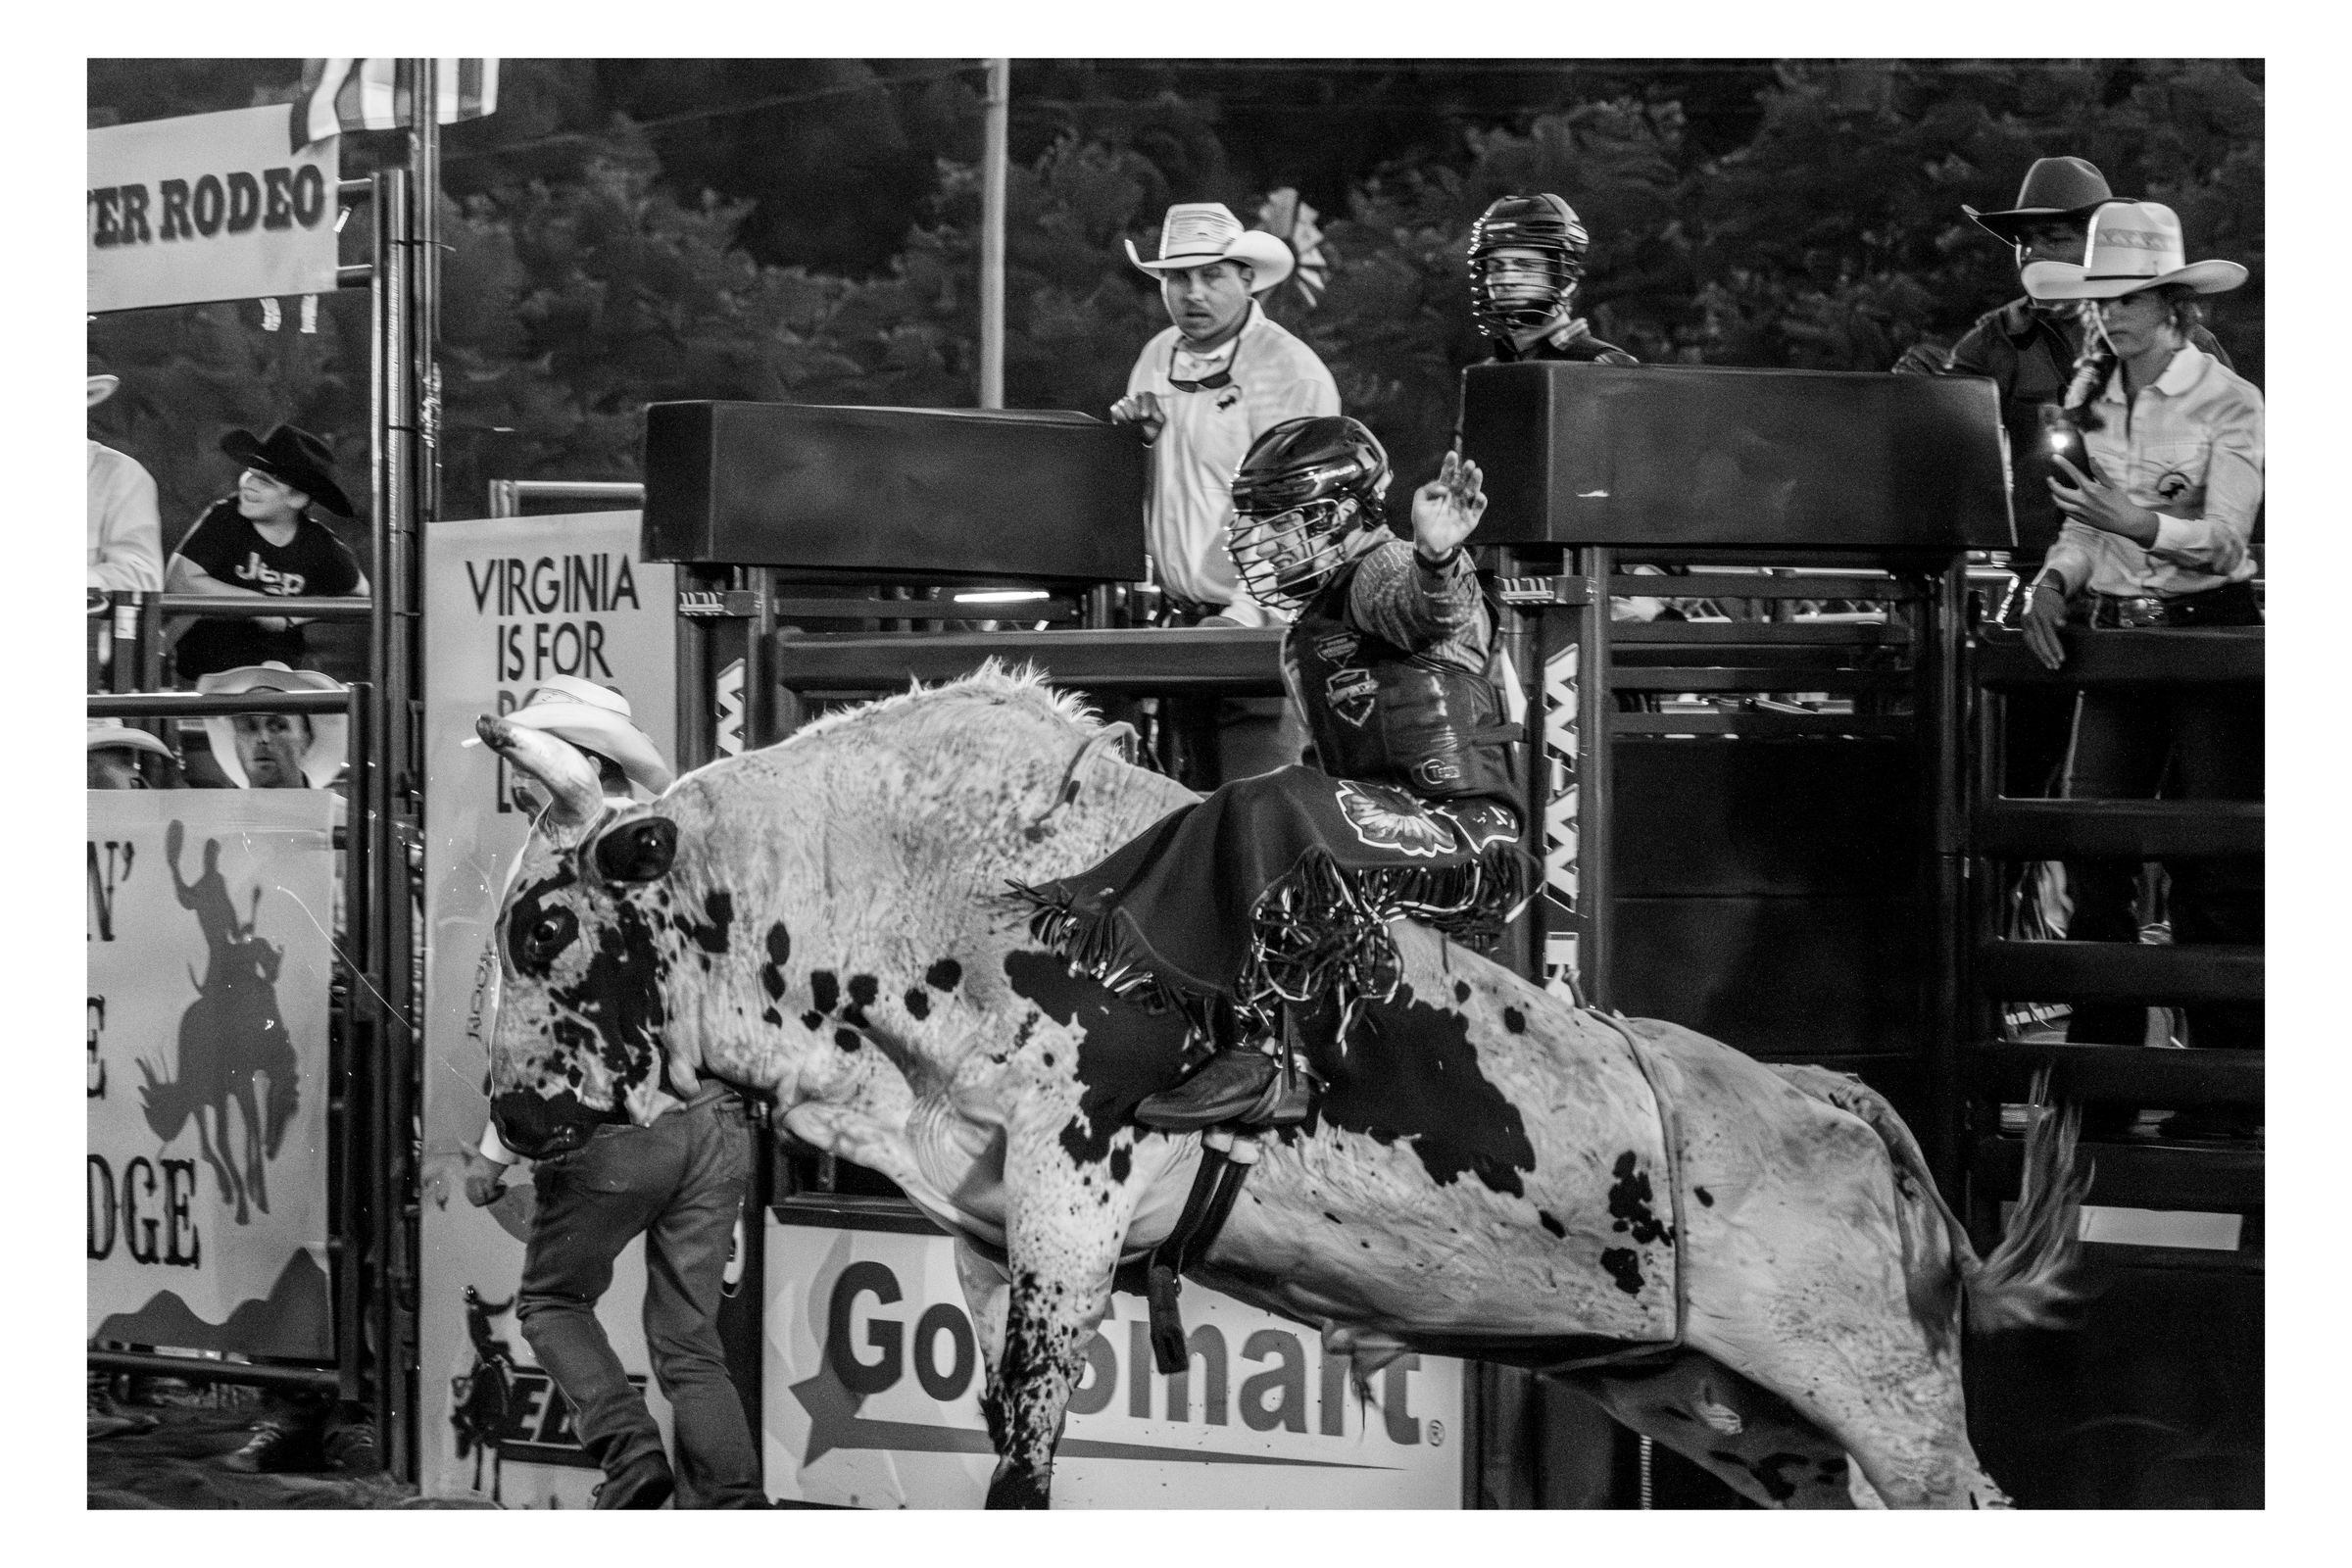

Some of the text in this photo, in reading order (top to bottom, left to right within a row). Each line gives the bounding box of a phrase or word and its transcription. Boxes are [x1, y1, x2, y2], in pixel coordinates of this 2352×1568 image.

[87, 163, 324, 249] ER RODEO
[235, 551, 306, 596] Jeep
[465, 553, 641, 616] VIRGINIA
[497, 620, 614, 681] IS FOR
